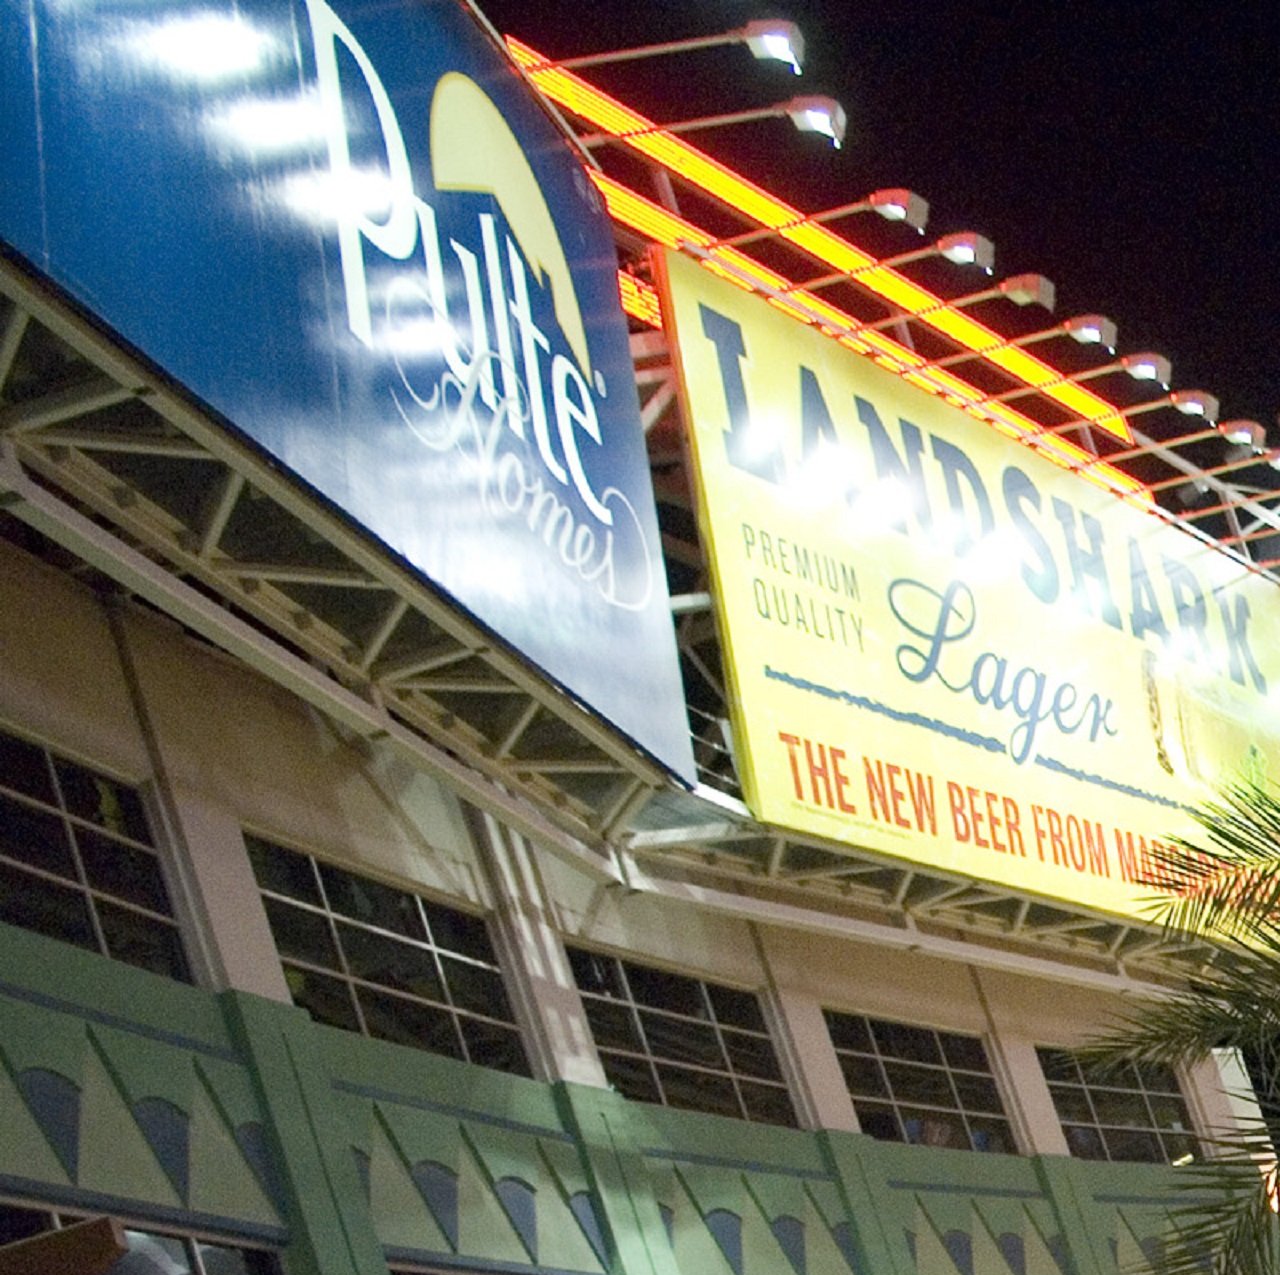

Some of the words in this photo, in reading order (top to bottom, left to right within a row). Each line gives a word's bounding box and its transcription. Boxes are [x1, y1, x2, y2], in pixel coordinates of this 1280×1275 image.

[308, 0, 613, 524] Pulte
[743, 523, 861, 596] PREMIUM
[752, 577, 866, 653] QUALITY
[886, 577, 1120, 766] Lager
[779, 732, 856, 816] THE
[863, 755, 938, 836] NEW
[947, 780, 1026, 858] BEER
[1034, 803, 1110, 879] FROM
